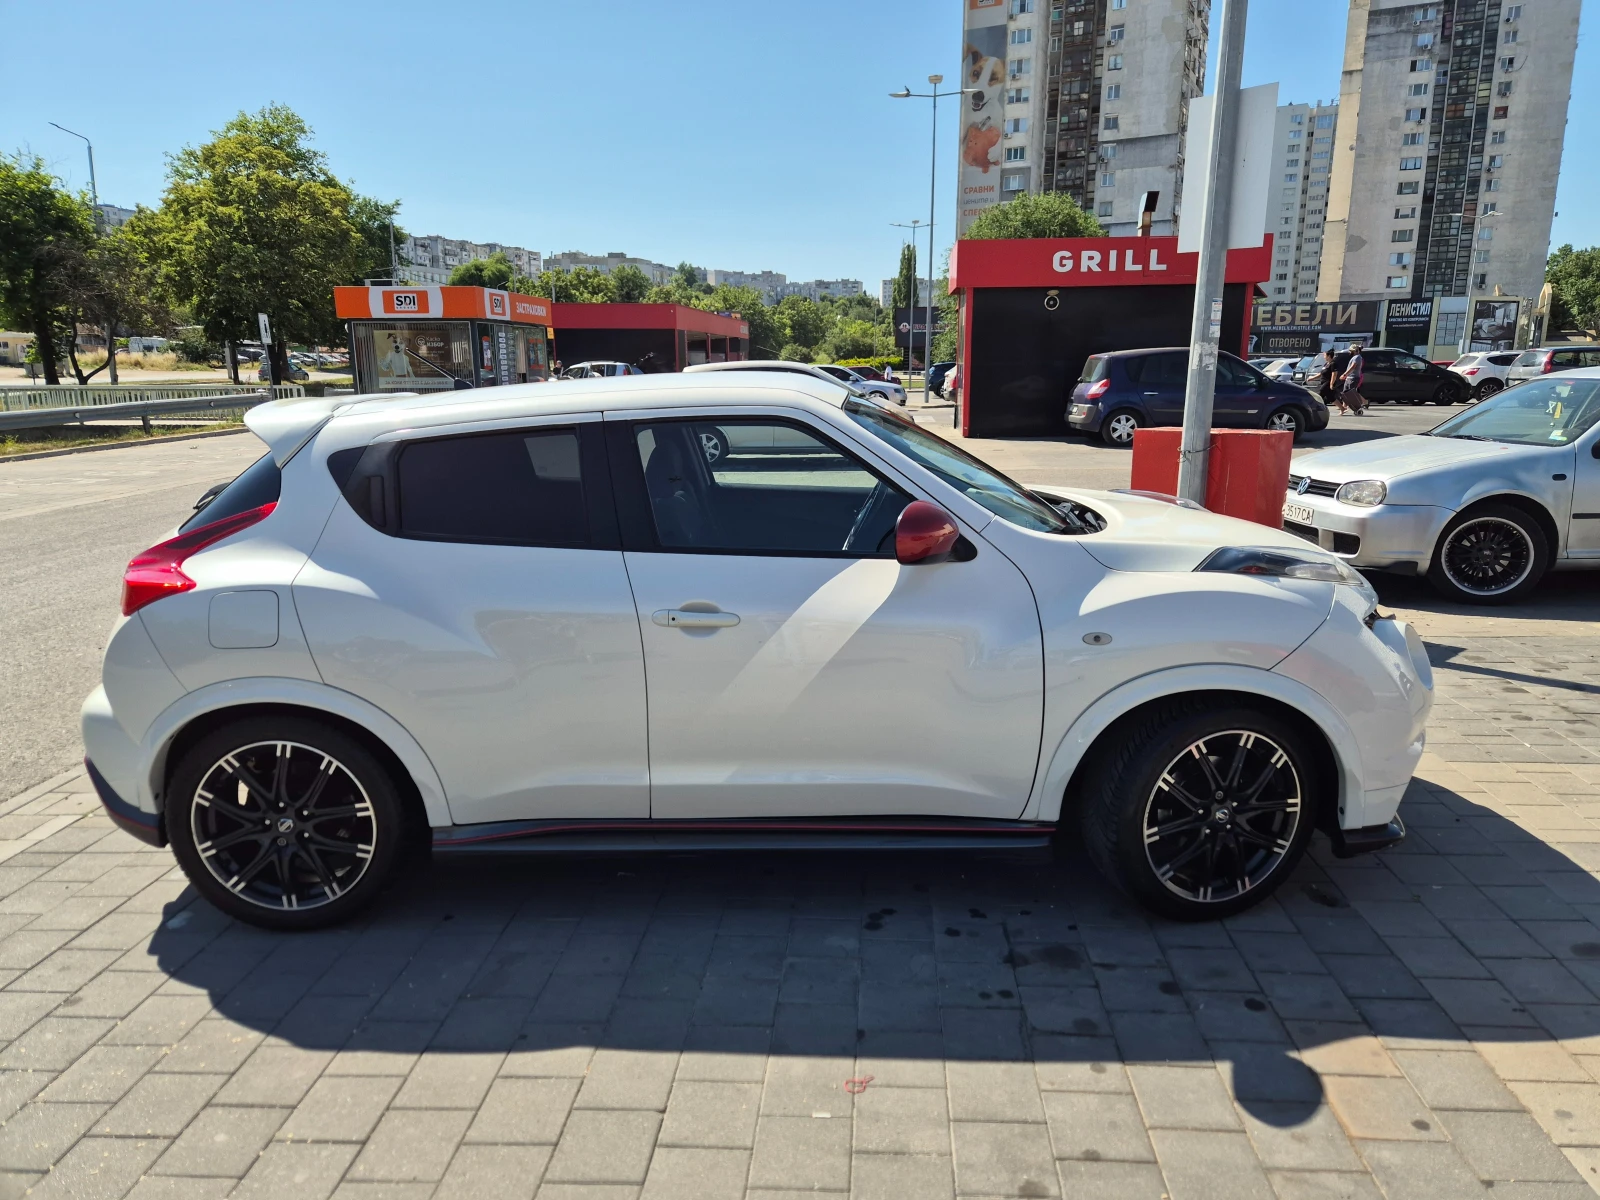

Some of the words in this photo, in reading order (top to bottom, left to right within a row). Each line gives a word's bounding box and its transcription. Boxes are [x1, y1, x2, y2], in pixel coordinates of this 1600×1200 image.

[963, 185, 995, 195] СРАВНИ
[1052, 248, 1167, 273] GRILL
[395, 295, 416, 306] SDI
[1250, 304, 1358, 326] ЕБЕЛИ
[1389, 302, 1431, 316] ЛЕНИСТИЛ
[1269, 337, 1311, 348] ОТВОРЕНО
